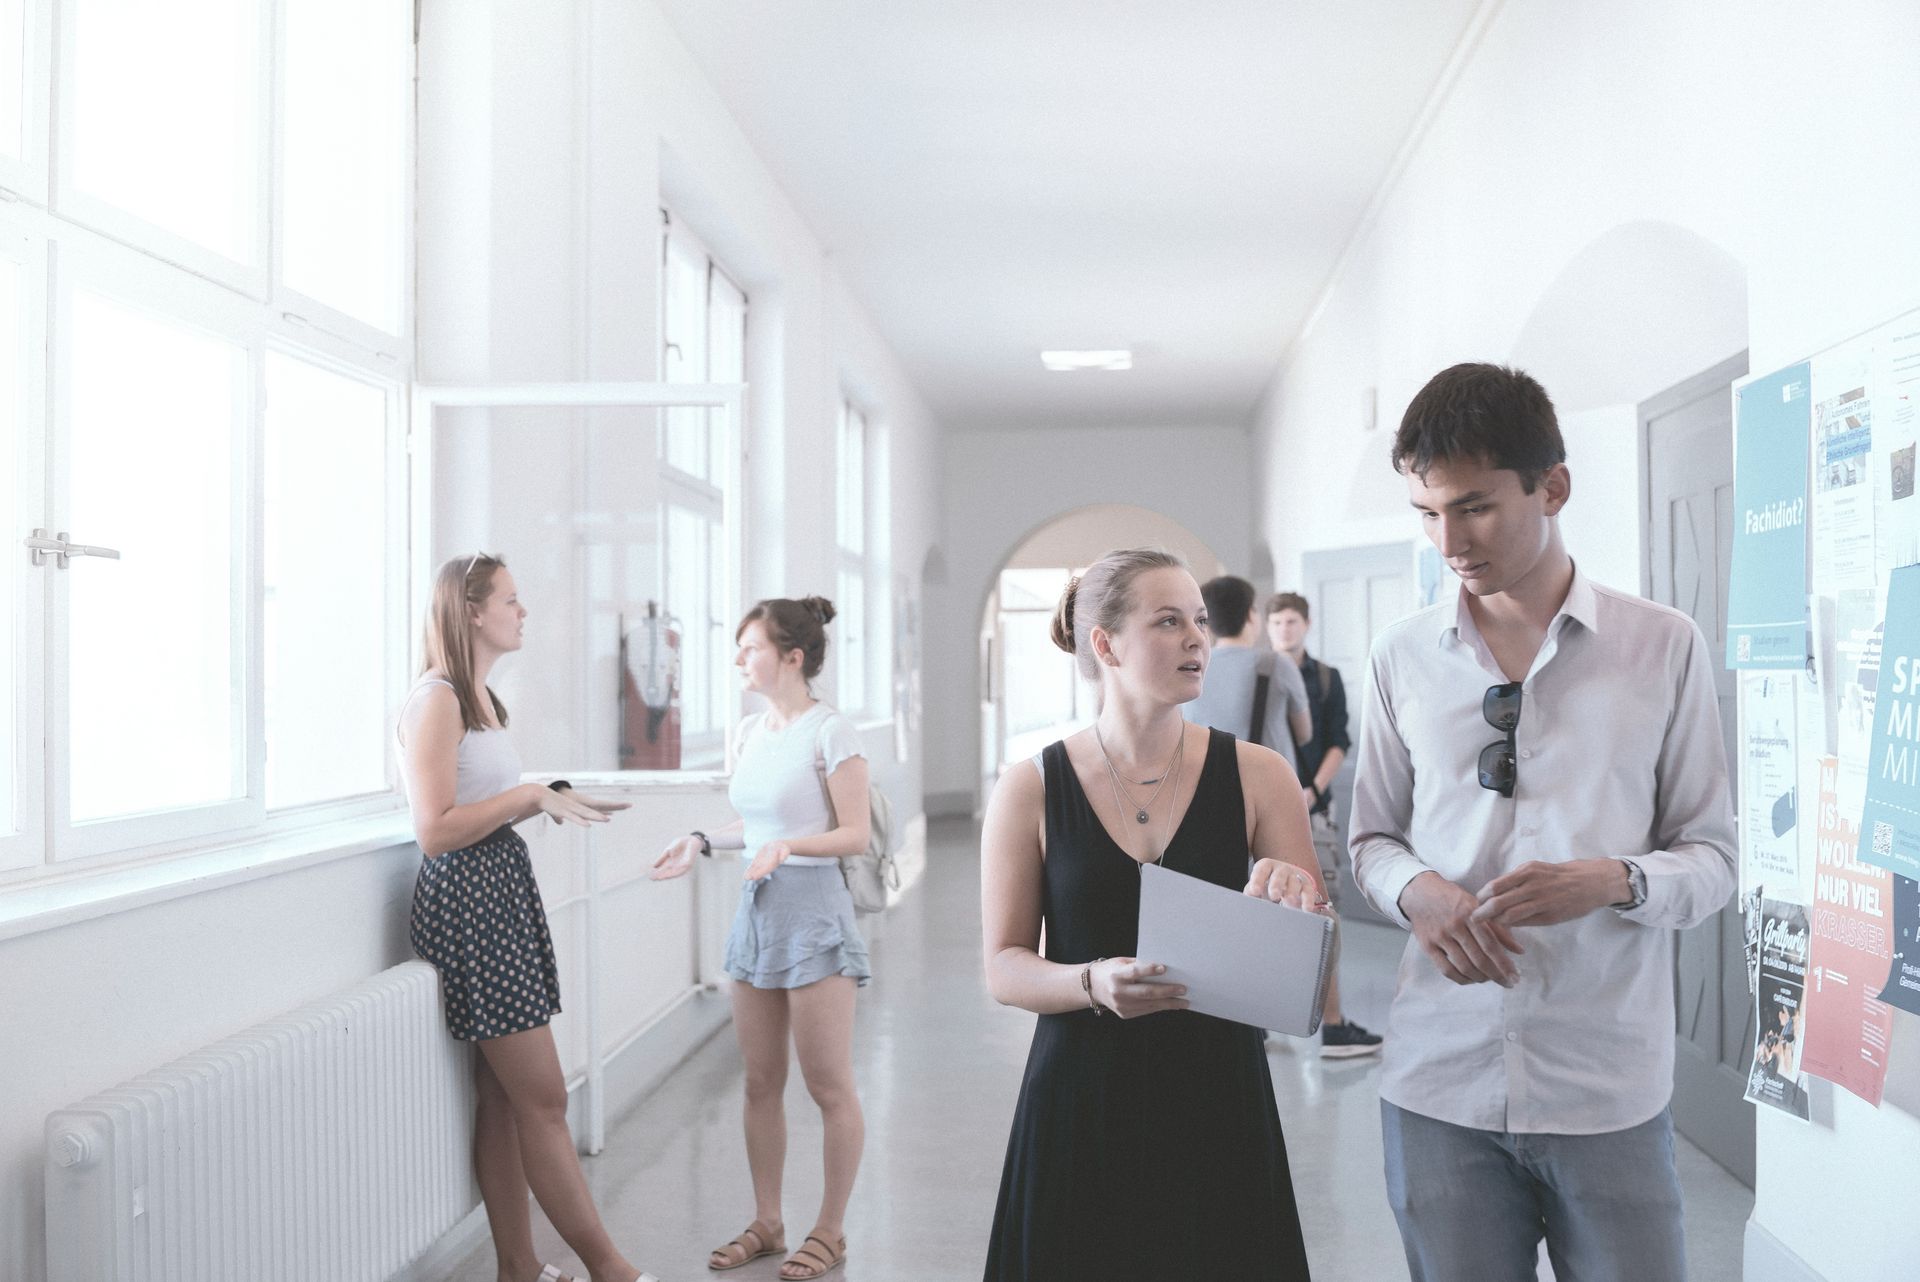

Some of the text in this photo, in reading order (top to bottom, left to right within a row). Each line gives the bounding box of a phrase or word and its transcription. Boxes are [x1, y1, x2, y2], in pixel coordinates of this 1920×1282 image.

[1745, 497, 1803, 535] Fachidiot?
[1817, 874, 1848, 908] NUR
[1850, 884, 1884, 917] VIEL
[1764, 918, 1806, 962] Grillparty
[1814, 908, 1889, 959] KRASSER.
